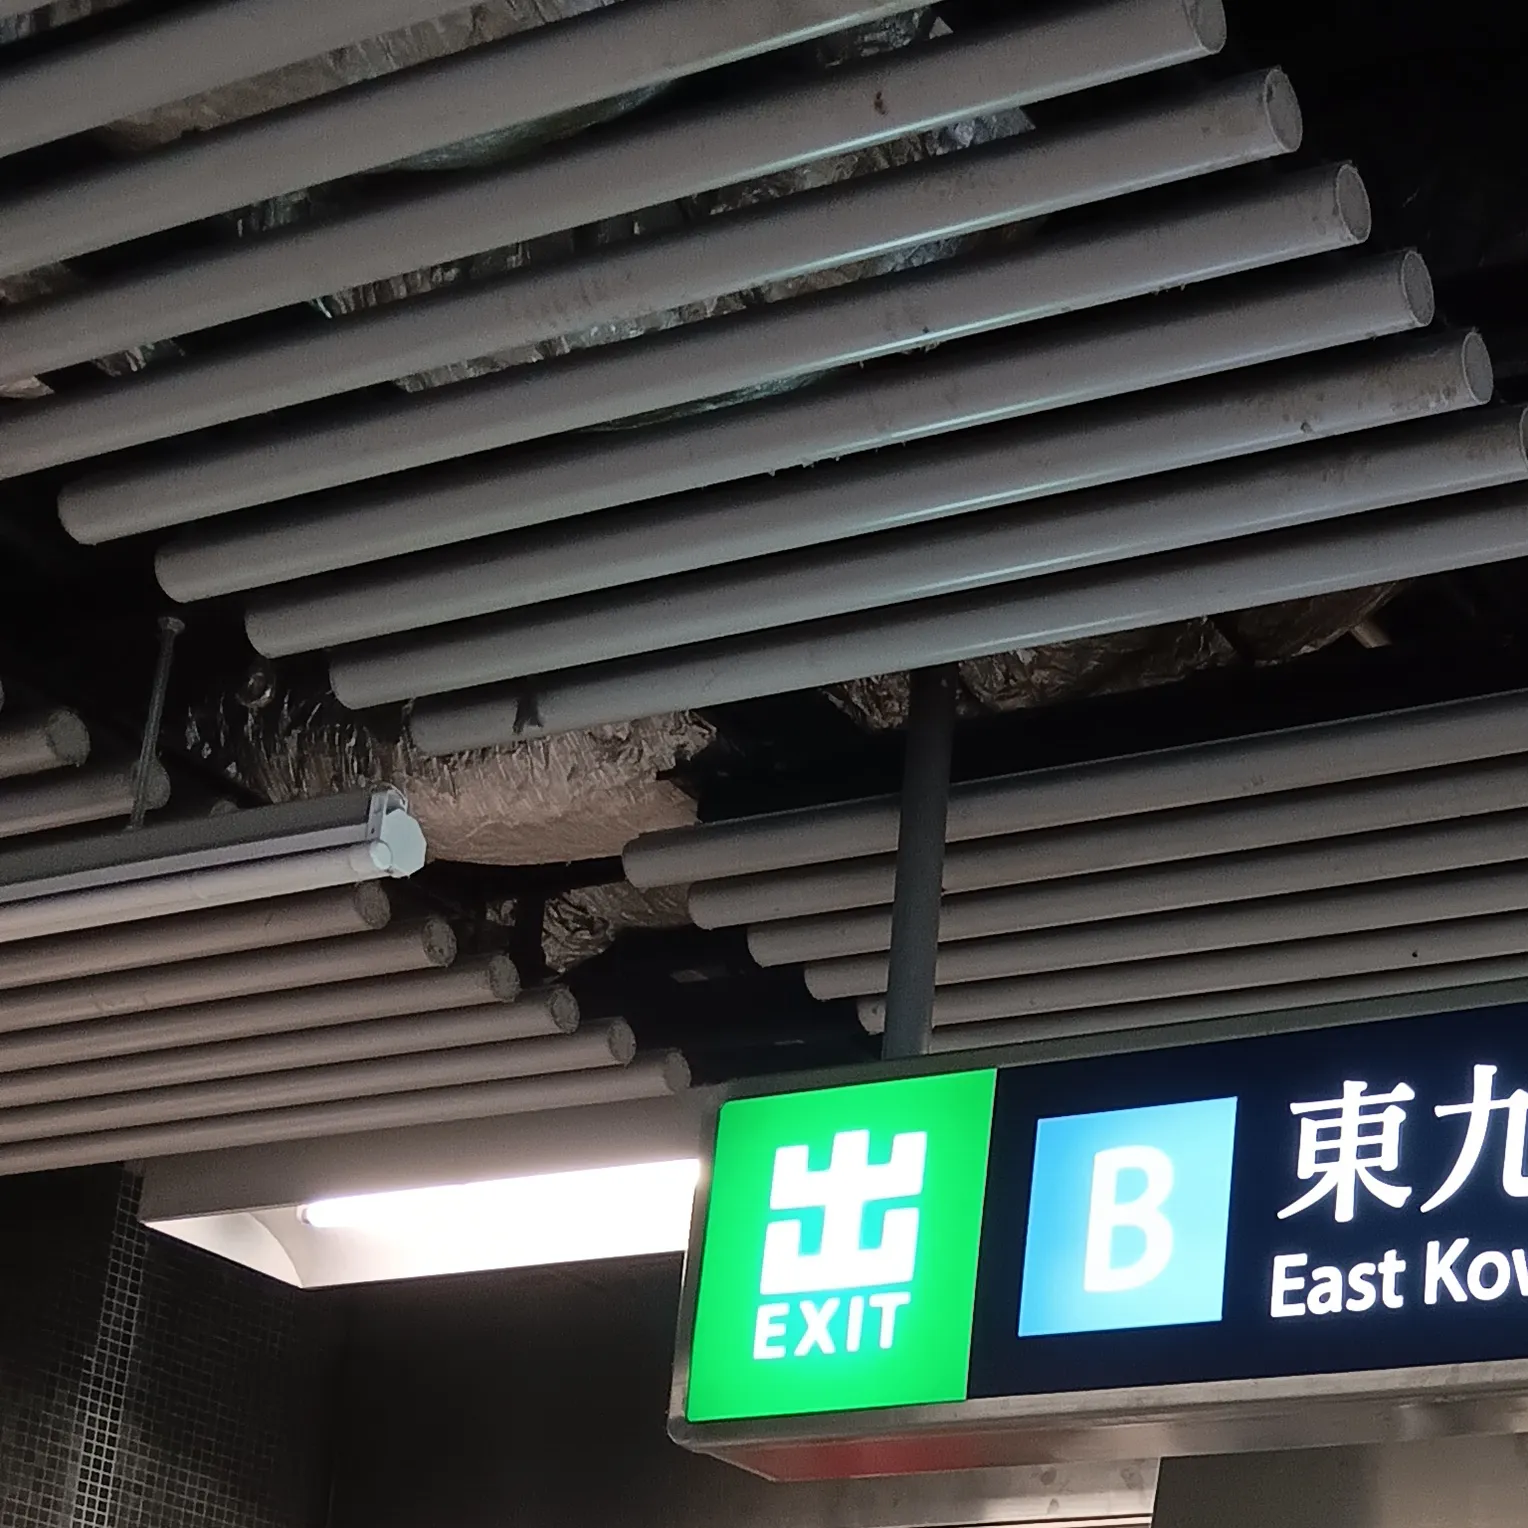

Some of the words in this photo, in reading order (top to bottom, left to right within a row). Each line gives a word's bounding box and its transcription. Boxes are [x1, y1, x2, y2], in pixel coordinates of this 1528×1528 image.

[759, 1129, 928, 1296] 出
[1084, 1145, 1174, 1292] B
[754, 1292, 911, 1359] EXIT
[1271, 1249, 1406, 1317] East
